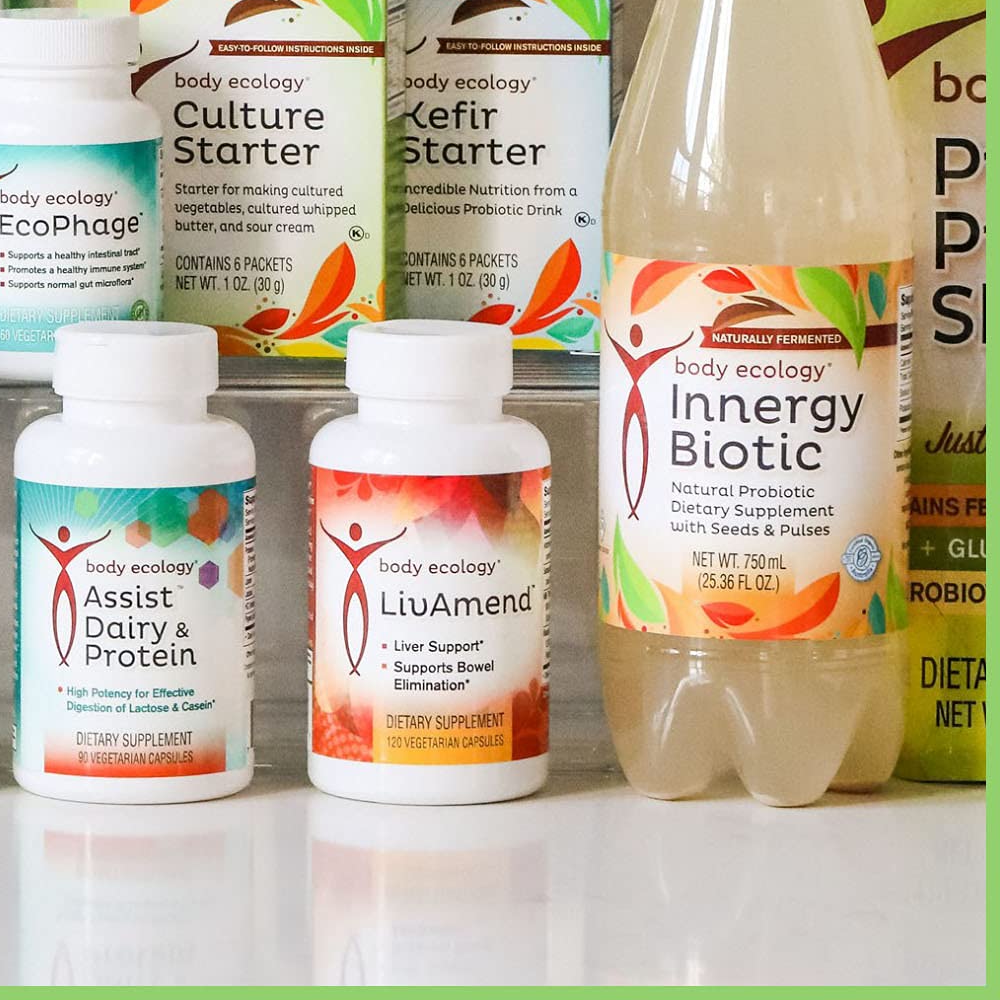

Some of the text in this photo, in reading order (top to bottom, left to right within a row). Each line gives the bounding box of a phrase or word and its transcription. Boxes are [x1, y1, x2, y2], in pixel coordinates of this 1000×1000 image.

[218, 44, 375, 55] EASY-TO-FOLLOW INSTRUCTIONS INSIDE
[175, 73, 223, 91] body
[173, 100, 325, 131] Culture
[174, 136, 320, 166] Starter
[405, 136, 546, 167] Starter
[0, 189, 40, 208] body
[175, 183, 344, 199] Starter for making cultured
[175, 201, 357, 218] vegetables, cultured whipped
[175, 220, 315, 235] butter, and sour cream
[175, 256, 293, 273] CONTAINS 6 PACKETS
[8, 279, 45, 291] Supports
[47, 280, 77, 290] normal
[79, 279, 93, 290] gut
[711, 331, 842, 345] NATURALLY FERMENTED
[675, 356, 728, 380] body
[671, 383, 864, 433] Innergy
[671, 430, 822, 471] Biotic
[671, 481, 815, 499] Natural Probiotic
[671, 500, 834, 520] Dietary Supplement
[670, 520, 830, 537] with Seeds & Pulses
[86, 559, 125, 576] body
[379, 557, 423, 575] body
[692, 551, 716, 568] NET
[718, 552, 740, 568] WT.
[83, 585, 174, 609] Assist
[86, 615, 190, 645] Dairy &
[86, 642, 197, 667] Protein
[395, 640, 424, 653] Liver
[394, 660, 495, 674] Supports Bowel
[76, 731, 193, 747] DIETARY SUPPLEMENT
